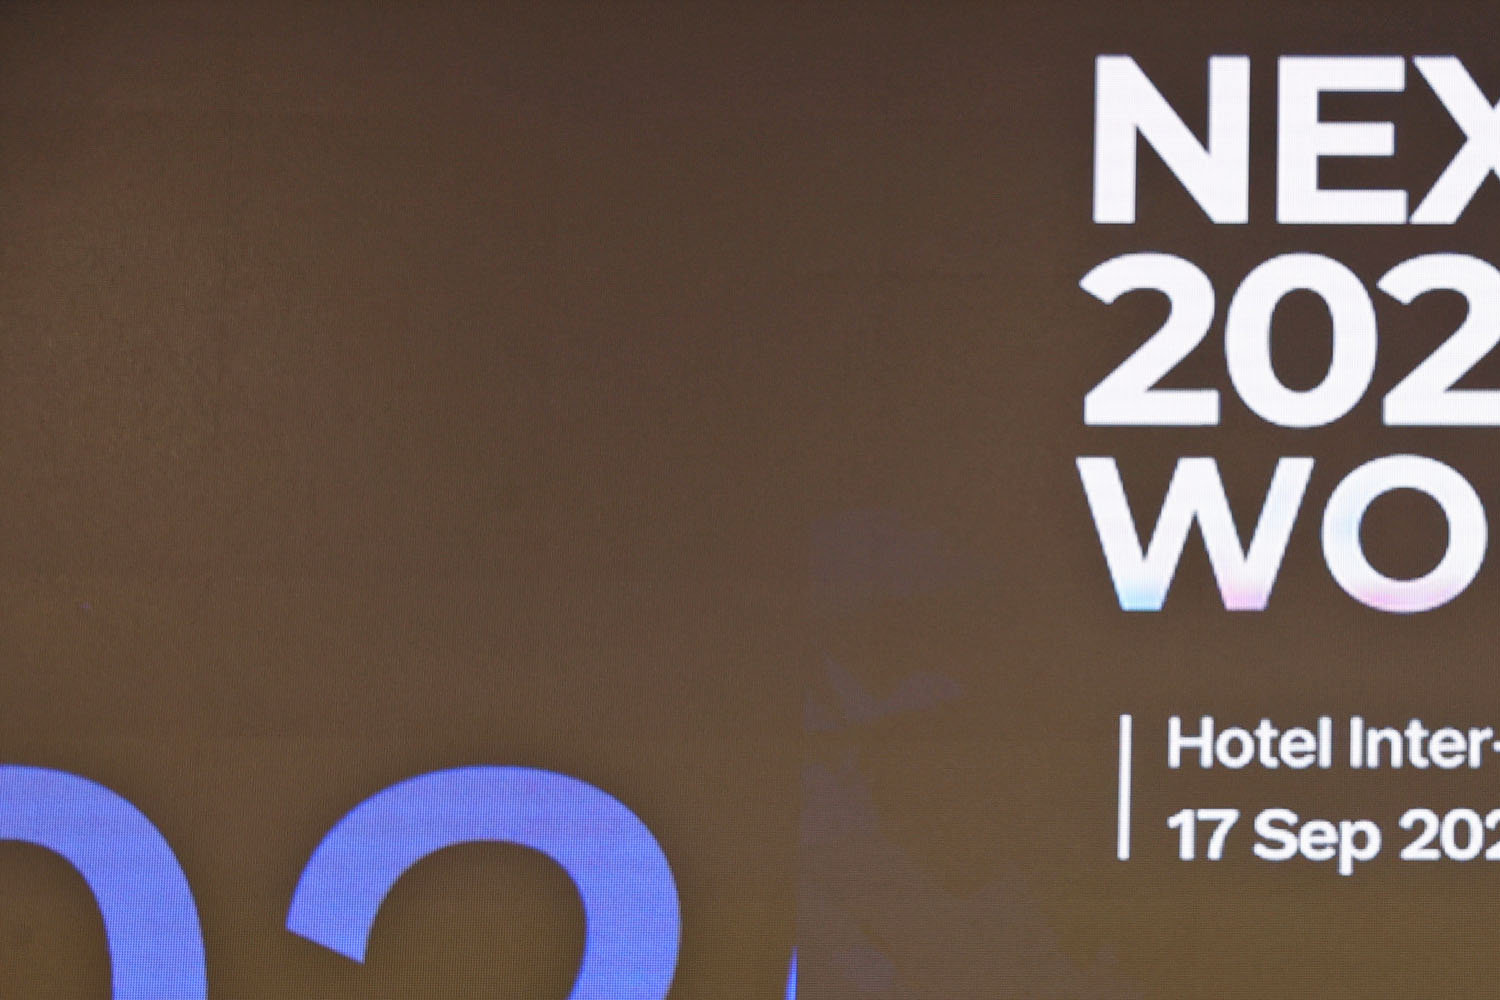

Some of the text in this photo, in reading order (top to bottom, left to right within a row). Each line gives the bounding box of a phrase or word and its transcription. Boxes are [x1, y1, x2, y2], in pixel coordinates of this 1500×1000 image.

[1166, 715, 1333, 769] Hotel
[1166, 808, 1241, 861] 17
[1252, 808, 1382, 877] Sep
